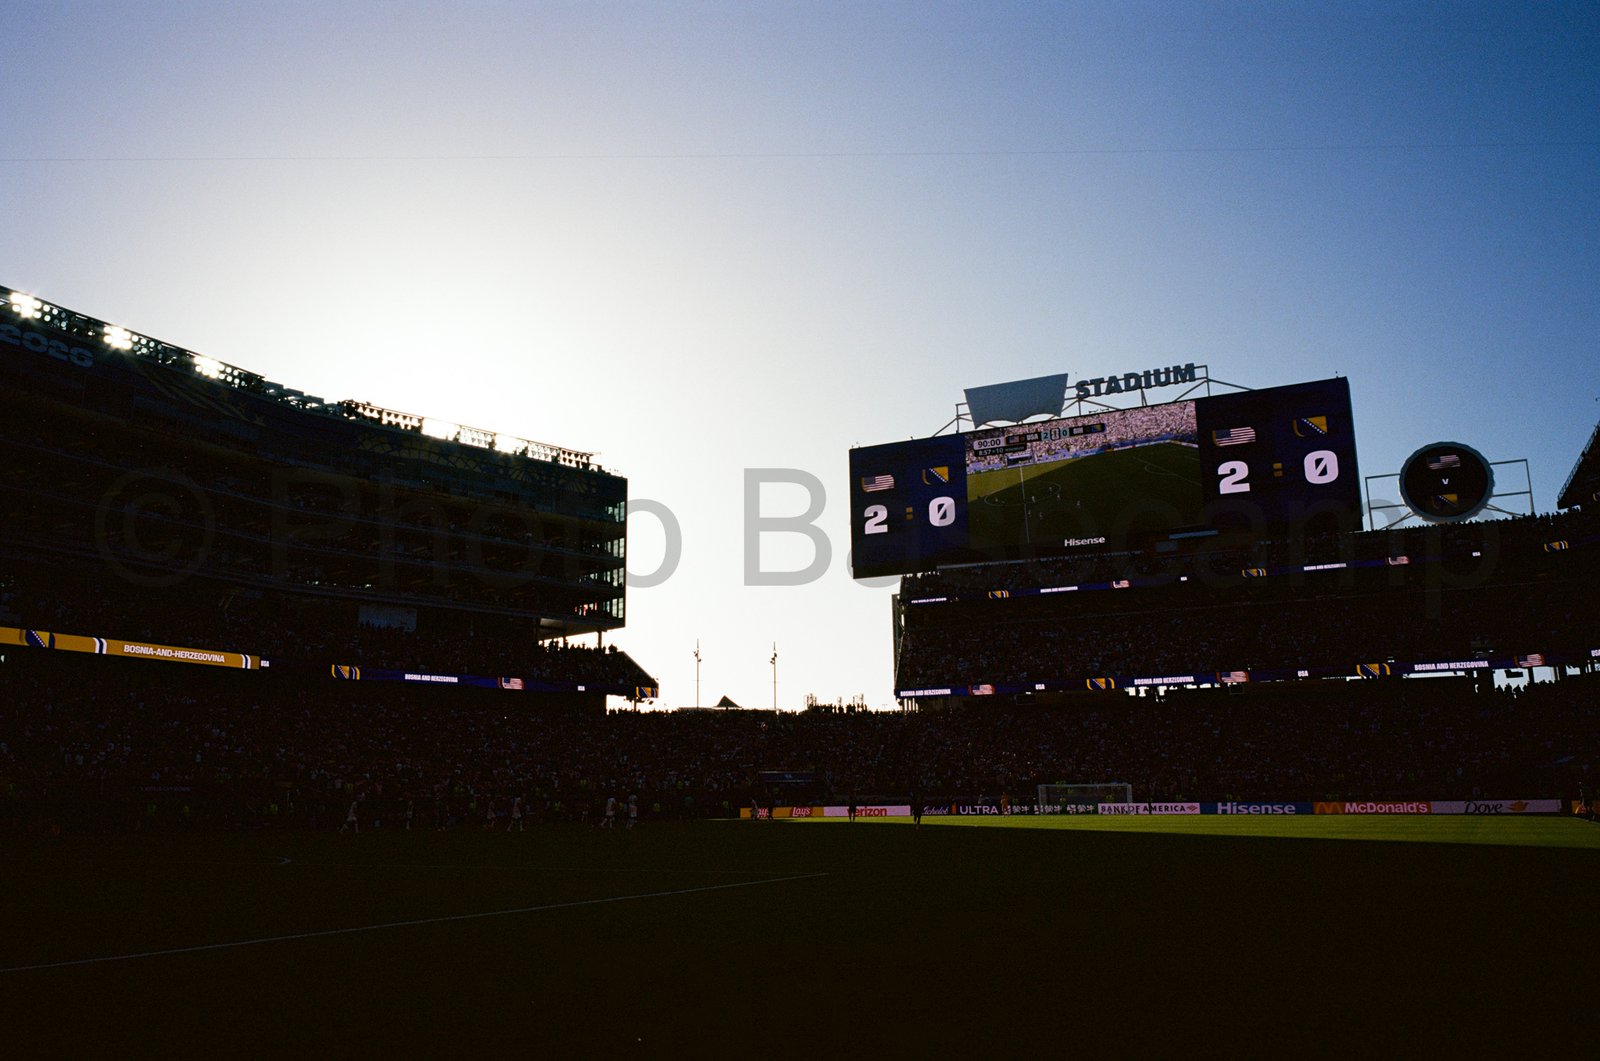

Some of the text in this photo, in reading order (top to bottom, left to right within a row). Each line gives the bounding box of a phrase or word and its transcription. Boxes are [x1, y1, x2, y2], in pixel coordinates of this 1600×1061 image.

[0, 323, 94, 369] 2026
[1076, 363, 1196, 400] STADIUM
[978, 438, 1001, 448] 90:00
[1217, 460, 1250, 495] 2
[1303, 449, 1339, 485] 0
[864, 504, 888, 535] 2
[929, 496, 955, 527] 0
[1064, 536, 1106, 547] Hisense
[124, 644, 225, 663] BOSNIA-AND-HERZEGOVINA
[1297, 669, 1308, 677] USA
[1414, 663, 1436, 671] BOSNIA
[792, 806, 812, 817] Lay's
[960, 805, 999, 815] ULTRA
[1101, 805, 1186, 813] BANK OF AMERICA
[1217, 802, 1296, 815] Hisense
[1344, 801, 1428, 814] McDonald's
[1464, 800, 1503, 815] Dove
